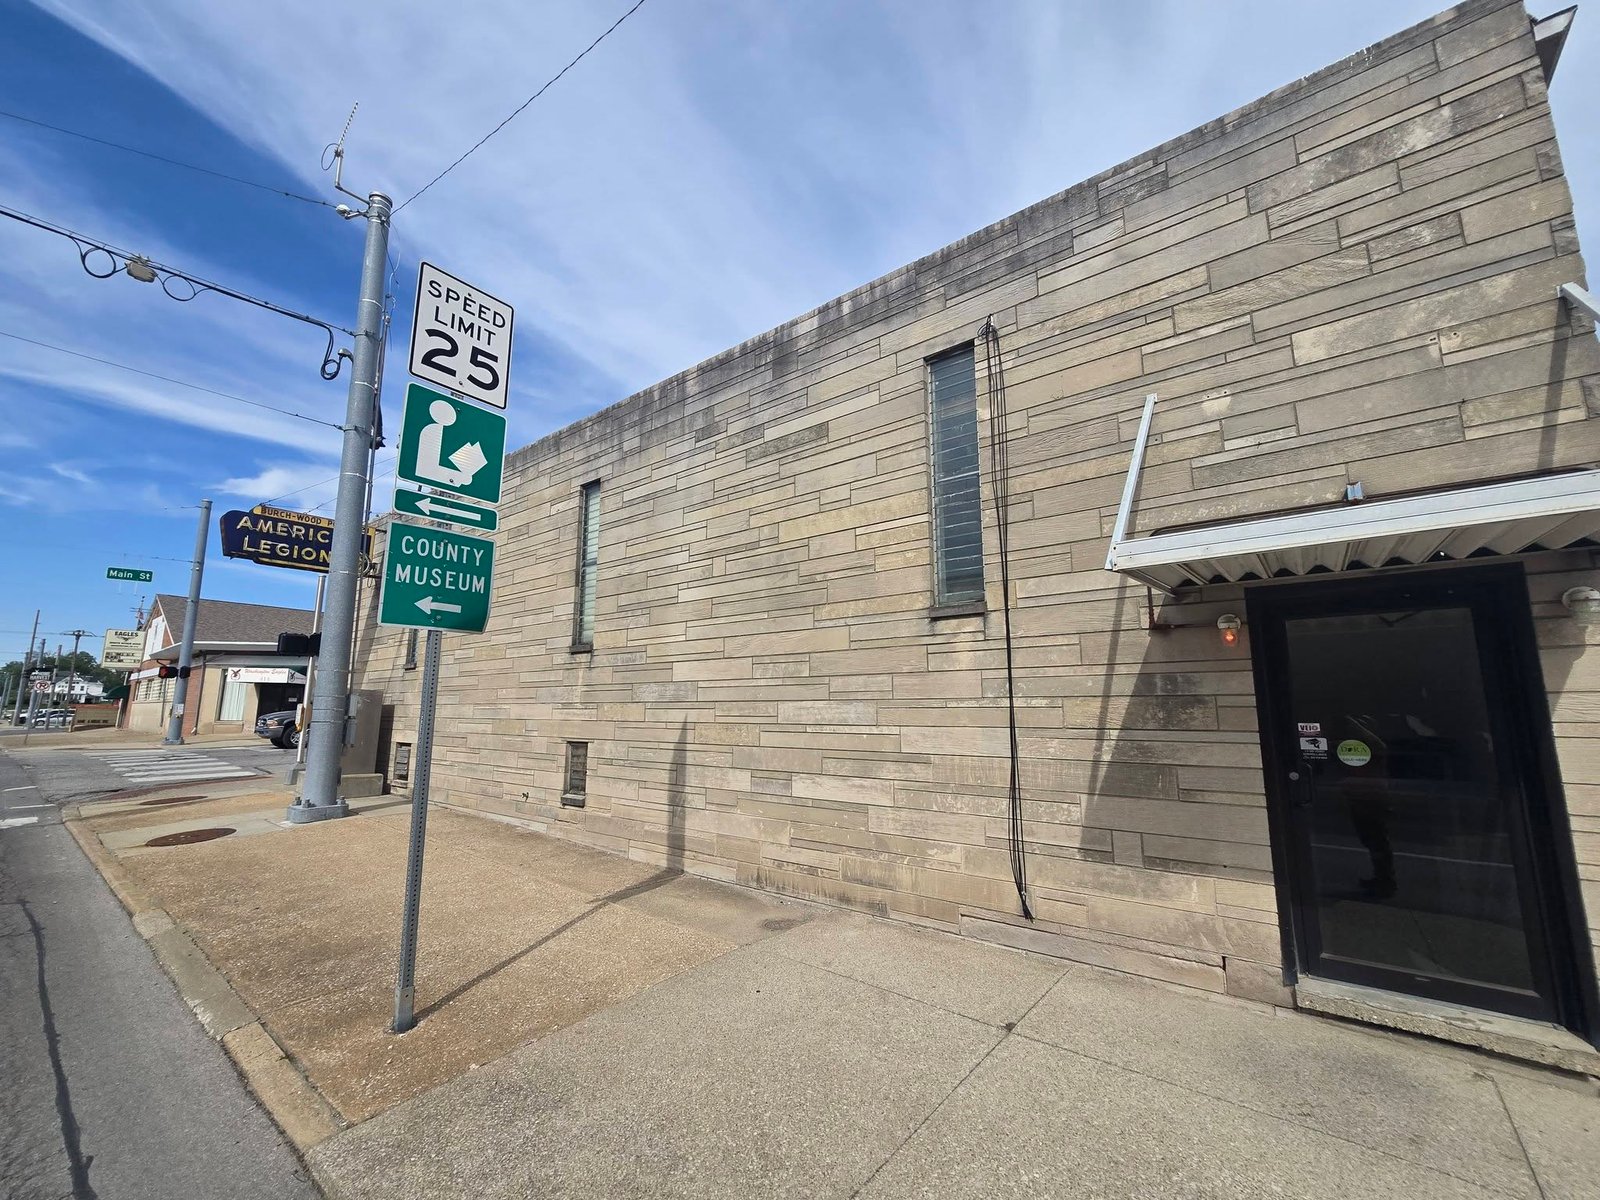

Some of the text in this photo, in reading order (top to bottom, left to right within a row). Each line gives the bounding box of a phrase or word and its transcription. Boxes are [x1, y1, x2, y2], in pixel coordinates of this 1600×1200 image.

[427, 280, 506, 328] SPEED
[434, 305, 496, 346] LIMIT
[421, 328, 500, 391] 25
[236, 515, 331, 544] AMERIC
[260, 507, 322, 525] BURCH-WOOD
[242, 534, 332, 563] LEGION
[401, 535, 485, 567] COUNTY
[109, 569, 151, 580] Main St
[394, 563, 486, 594] MUSEUM
